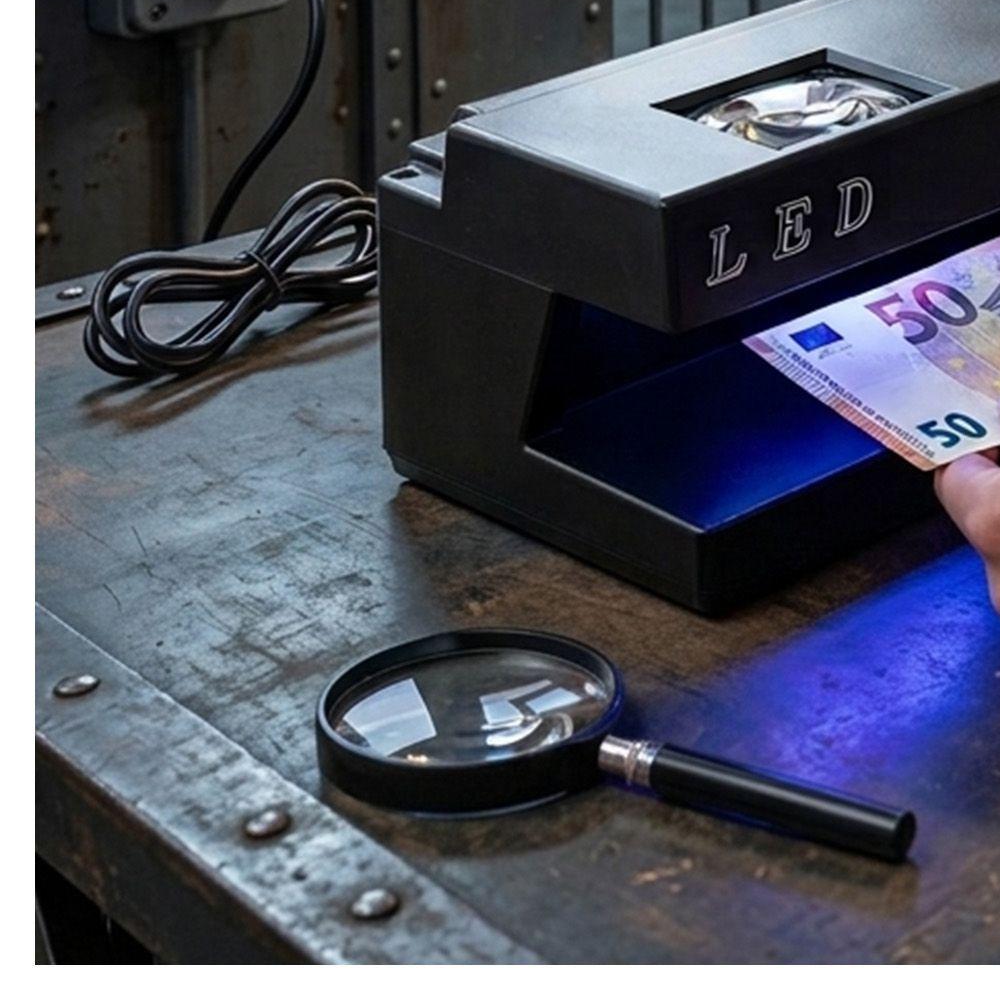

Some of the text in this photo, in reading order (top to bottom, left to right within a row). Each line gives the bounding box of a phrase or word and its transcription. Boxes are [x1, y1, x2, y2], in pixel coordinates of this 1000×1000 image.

[706, 177, 873, 287] LED
[864, 280, 978, 345] 50
[916, 412, 988, 448] 50
